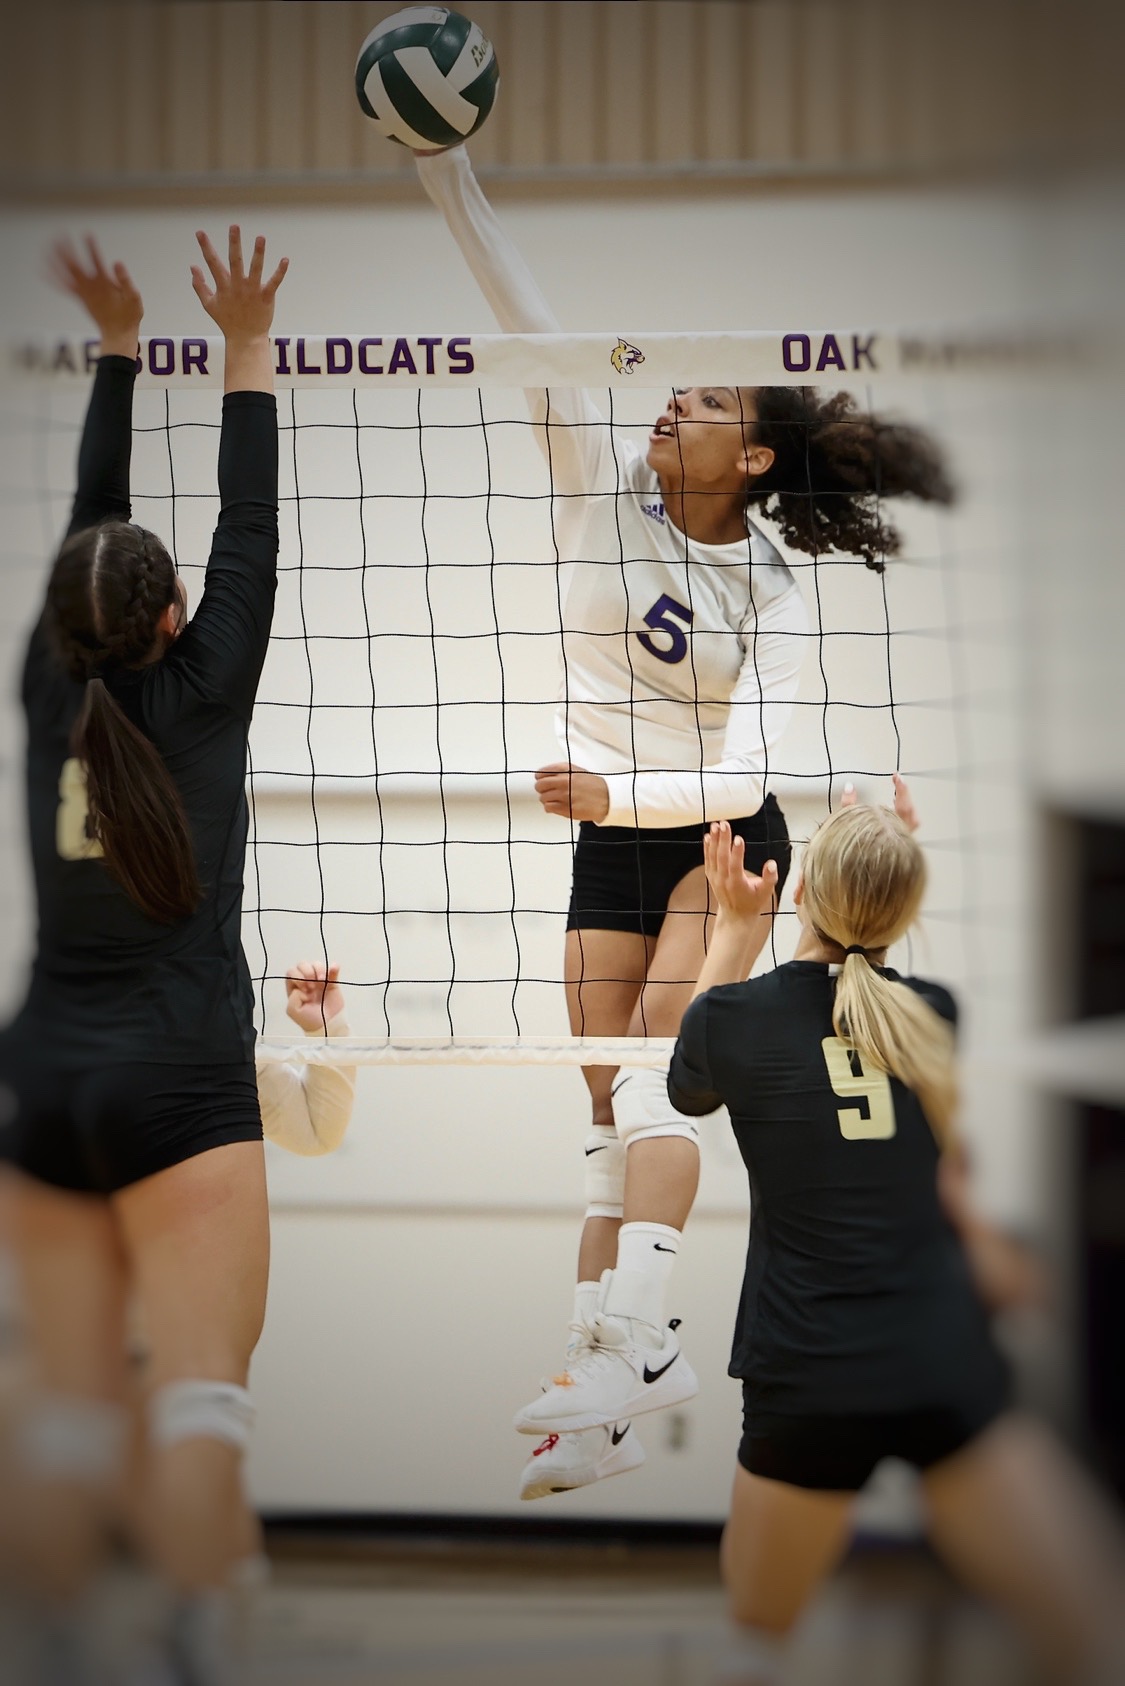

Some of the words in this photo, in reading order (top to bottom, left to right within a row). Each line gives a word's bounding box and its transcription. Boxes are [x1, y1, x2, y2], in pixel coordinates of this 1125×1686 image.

[17, 337, 209, 376] AROR
[269, 337, 475, 375] ILDCATS
[782, 333, 877, 372] OAK
[636, 593, 694, 664] 5
[821, 1036, 897, 1141] 9
